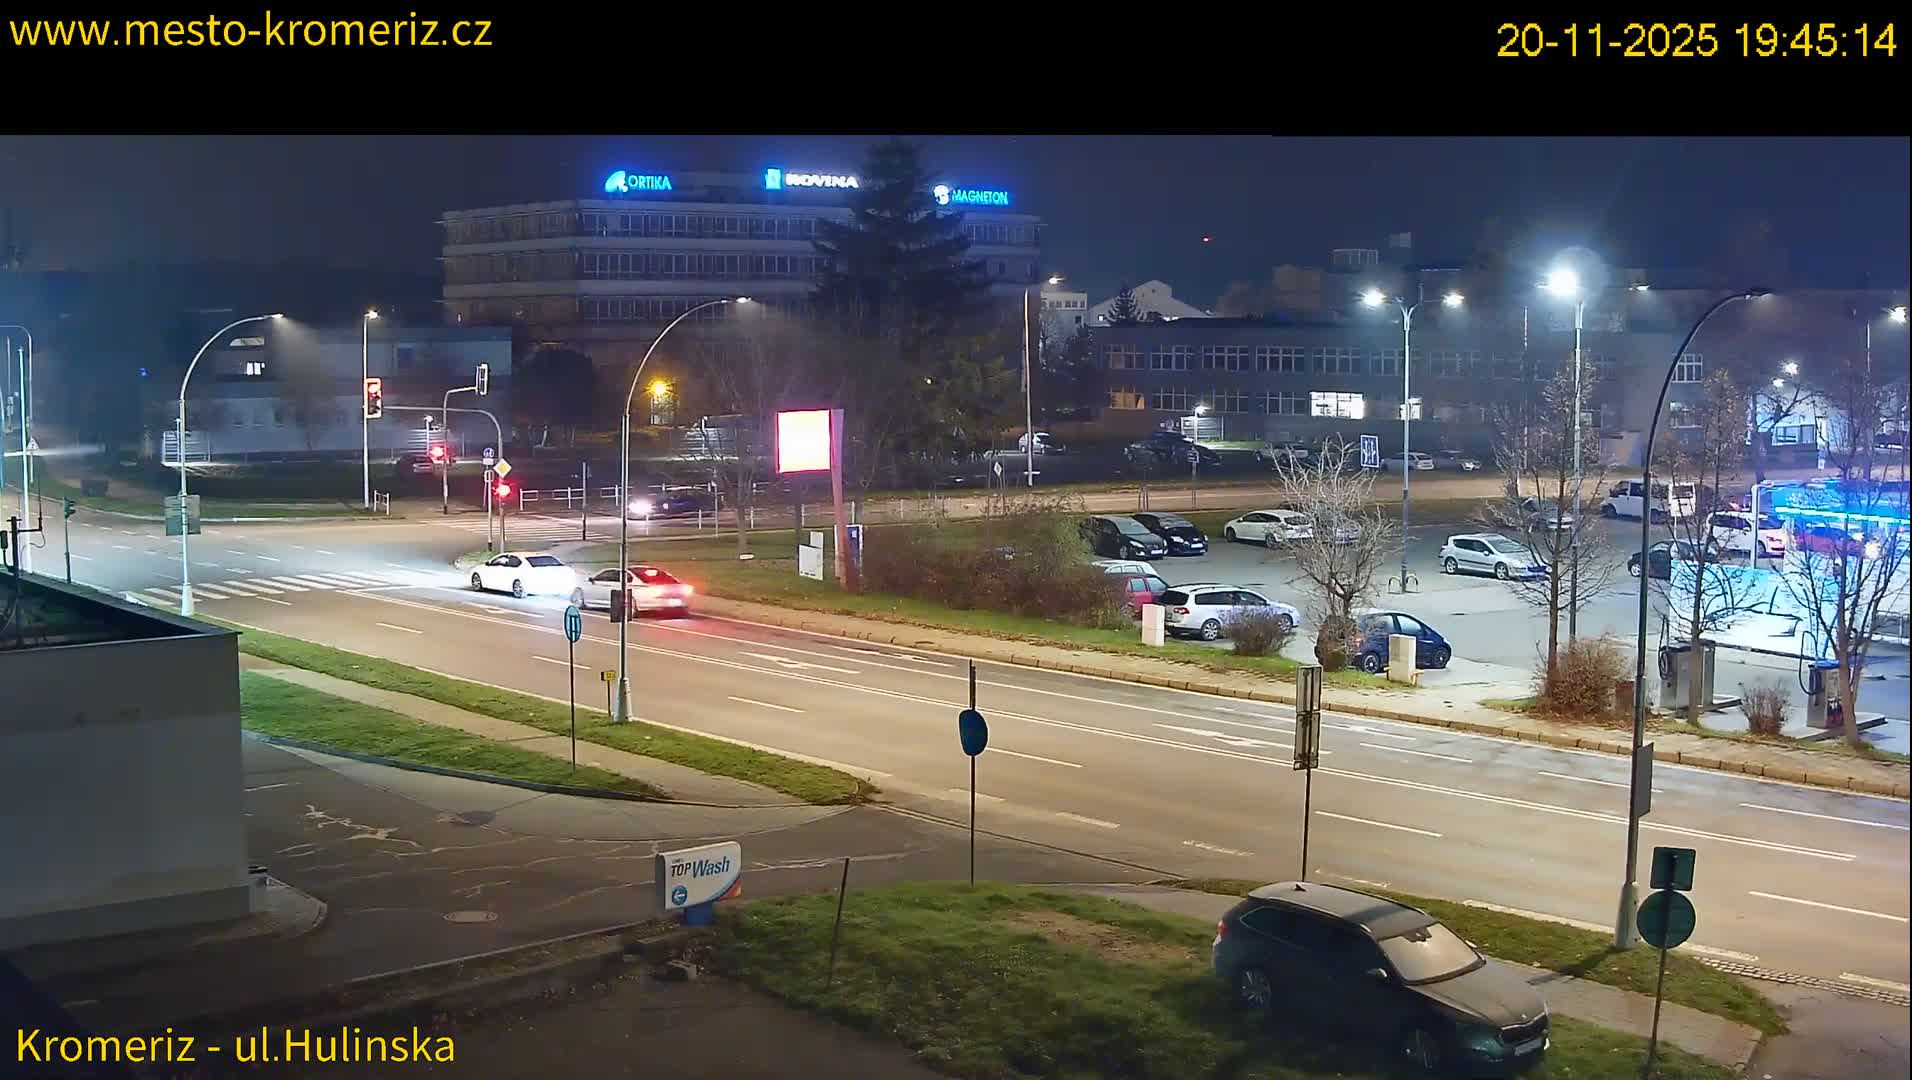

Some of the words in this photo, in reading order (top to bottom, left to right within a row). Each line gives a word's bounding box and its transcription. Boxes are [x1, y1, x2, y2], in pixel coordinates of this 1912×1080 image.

[628, 174, 672, 192] ORTIKA
[785, 173, 859, 189] ROVINA
[951, 189, 1009, 205] MAGNETON
